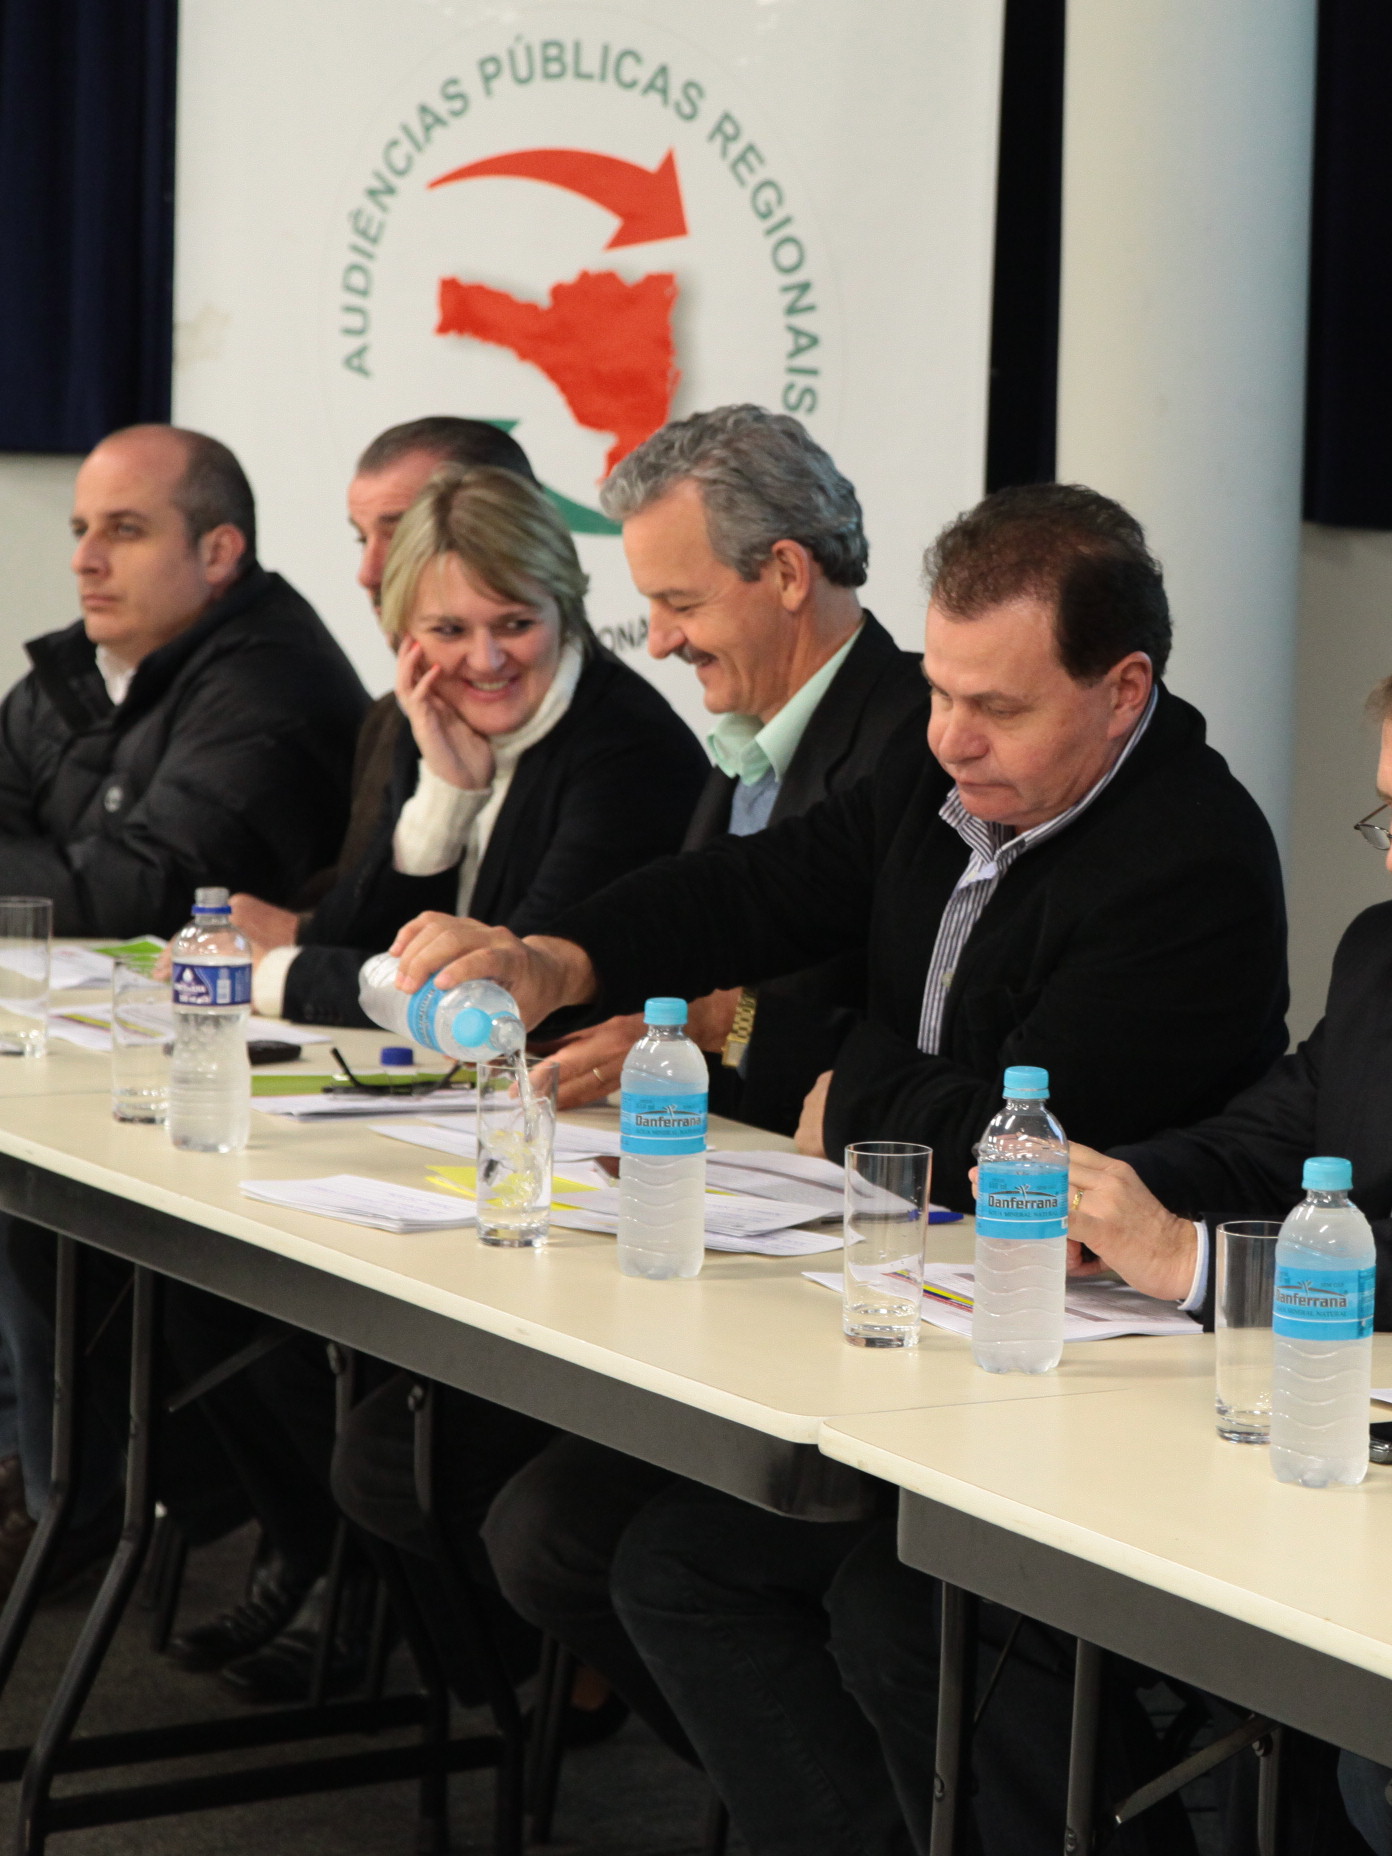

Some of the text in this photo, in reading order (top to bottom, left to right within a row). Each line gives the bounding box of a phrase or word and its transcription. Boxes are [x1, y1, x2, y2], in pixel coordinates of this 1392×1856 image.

[340, 36, 821, 415] AUDIÊNCIAS PÚBLICAS REGIONAIS
[635, 1115, 702, 1128] Danferrana
[988, 1195, 1058, 1210] Danferrana
